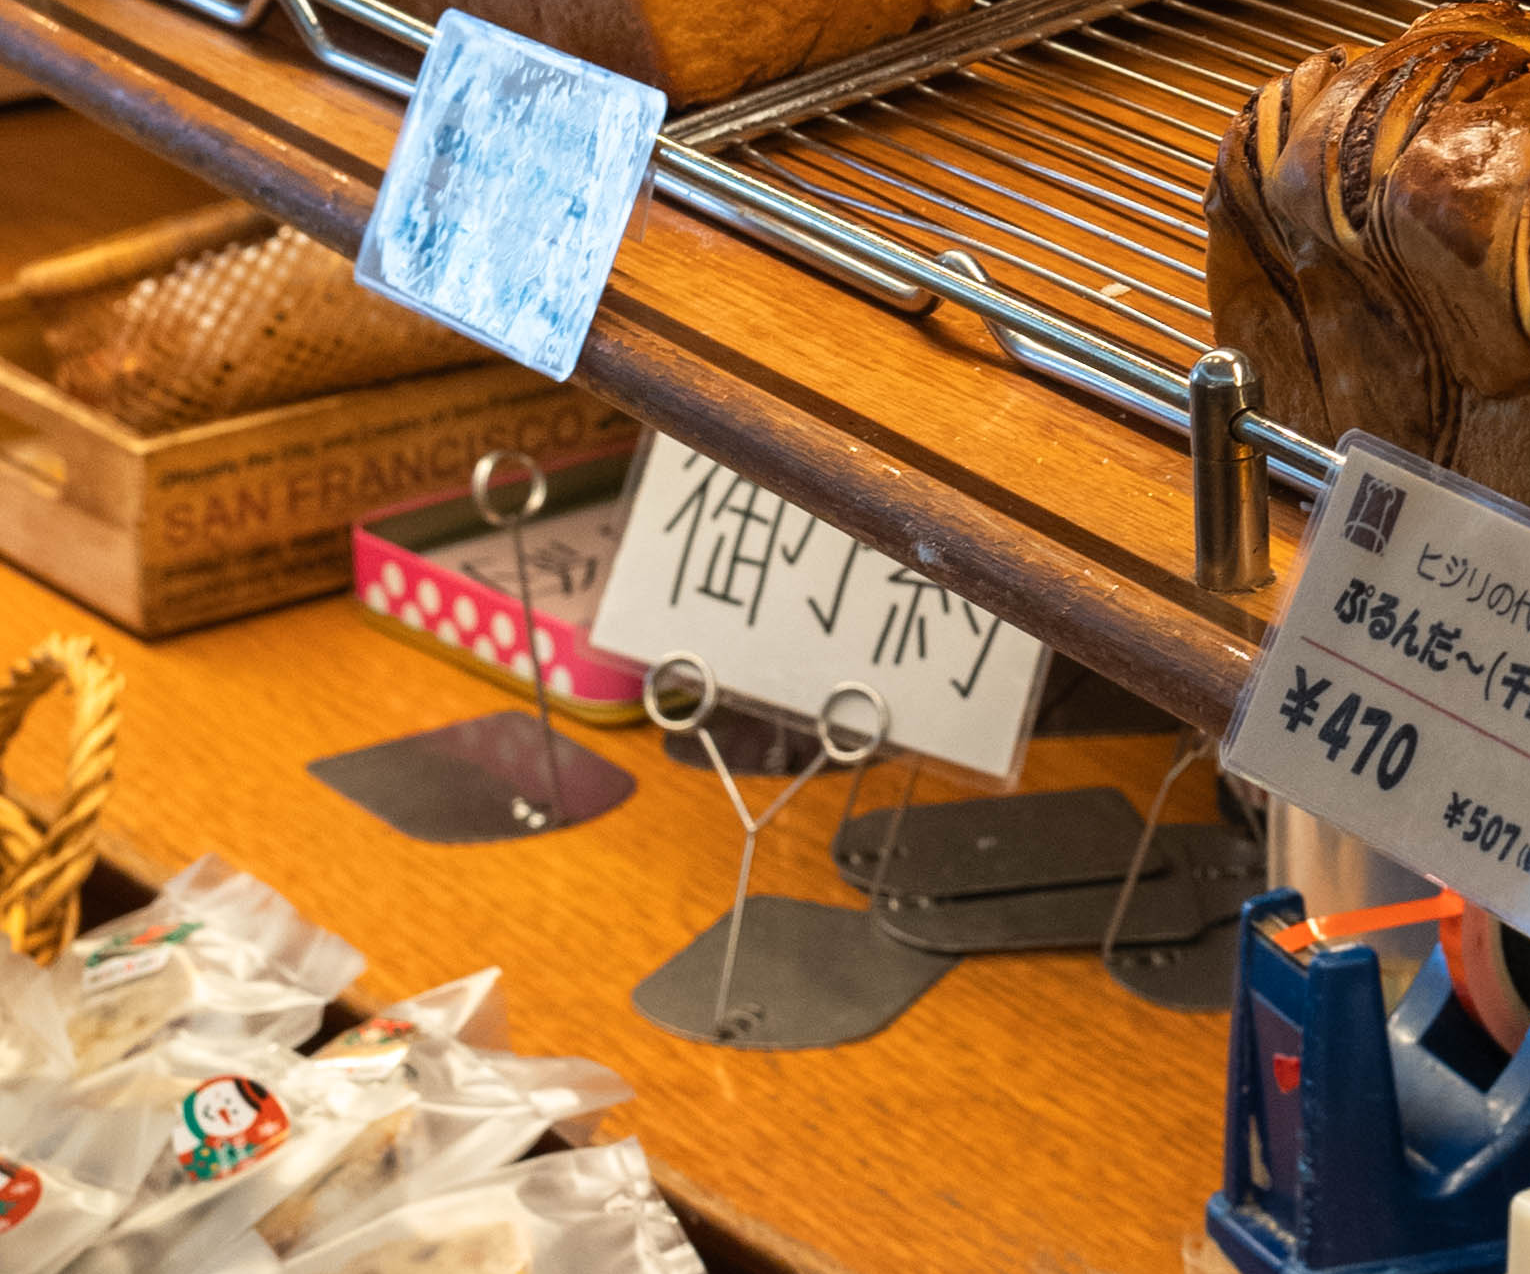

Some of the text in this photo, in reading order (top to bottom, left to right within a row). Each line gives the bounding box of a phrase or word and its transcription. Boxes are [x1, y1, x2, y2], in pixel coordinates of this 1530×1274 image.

[160, 482, 273, 548] SAN
[286, 406, 588, 518] FRANCISCO
[1279, 665, 1420, 792] ¥470
